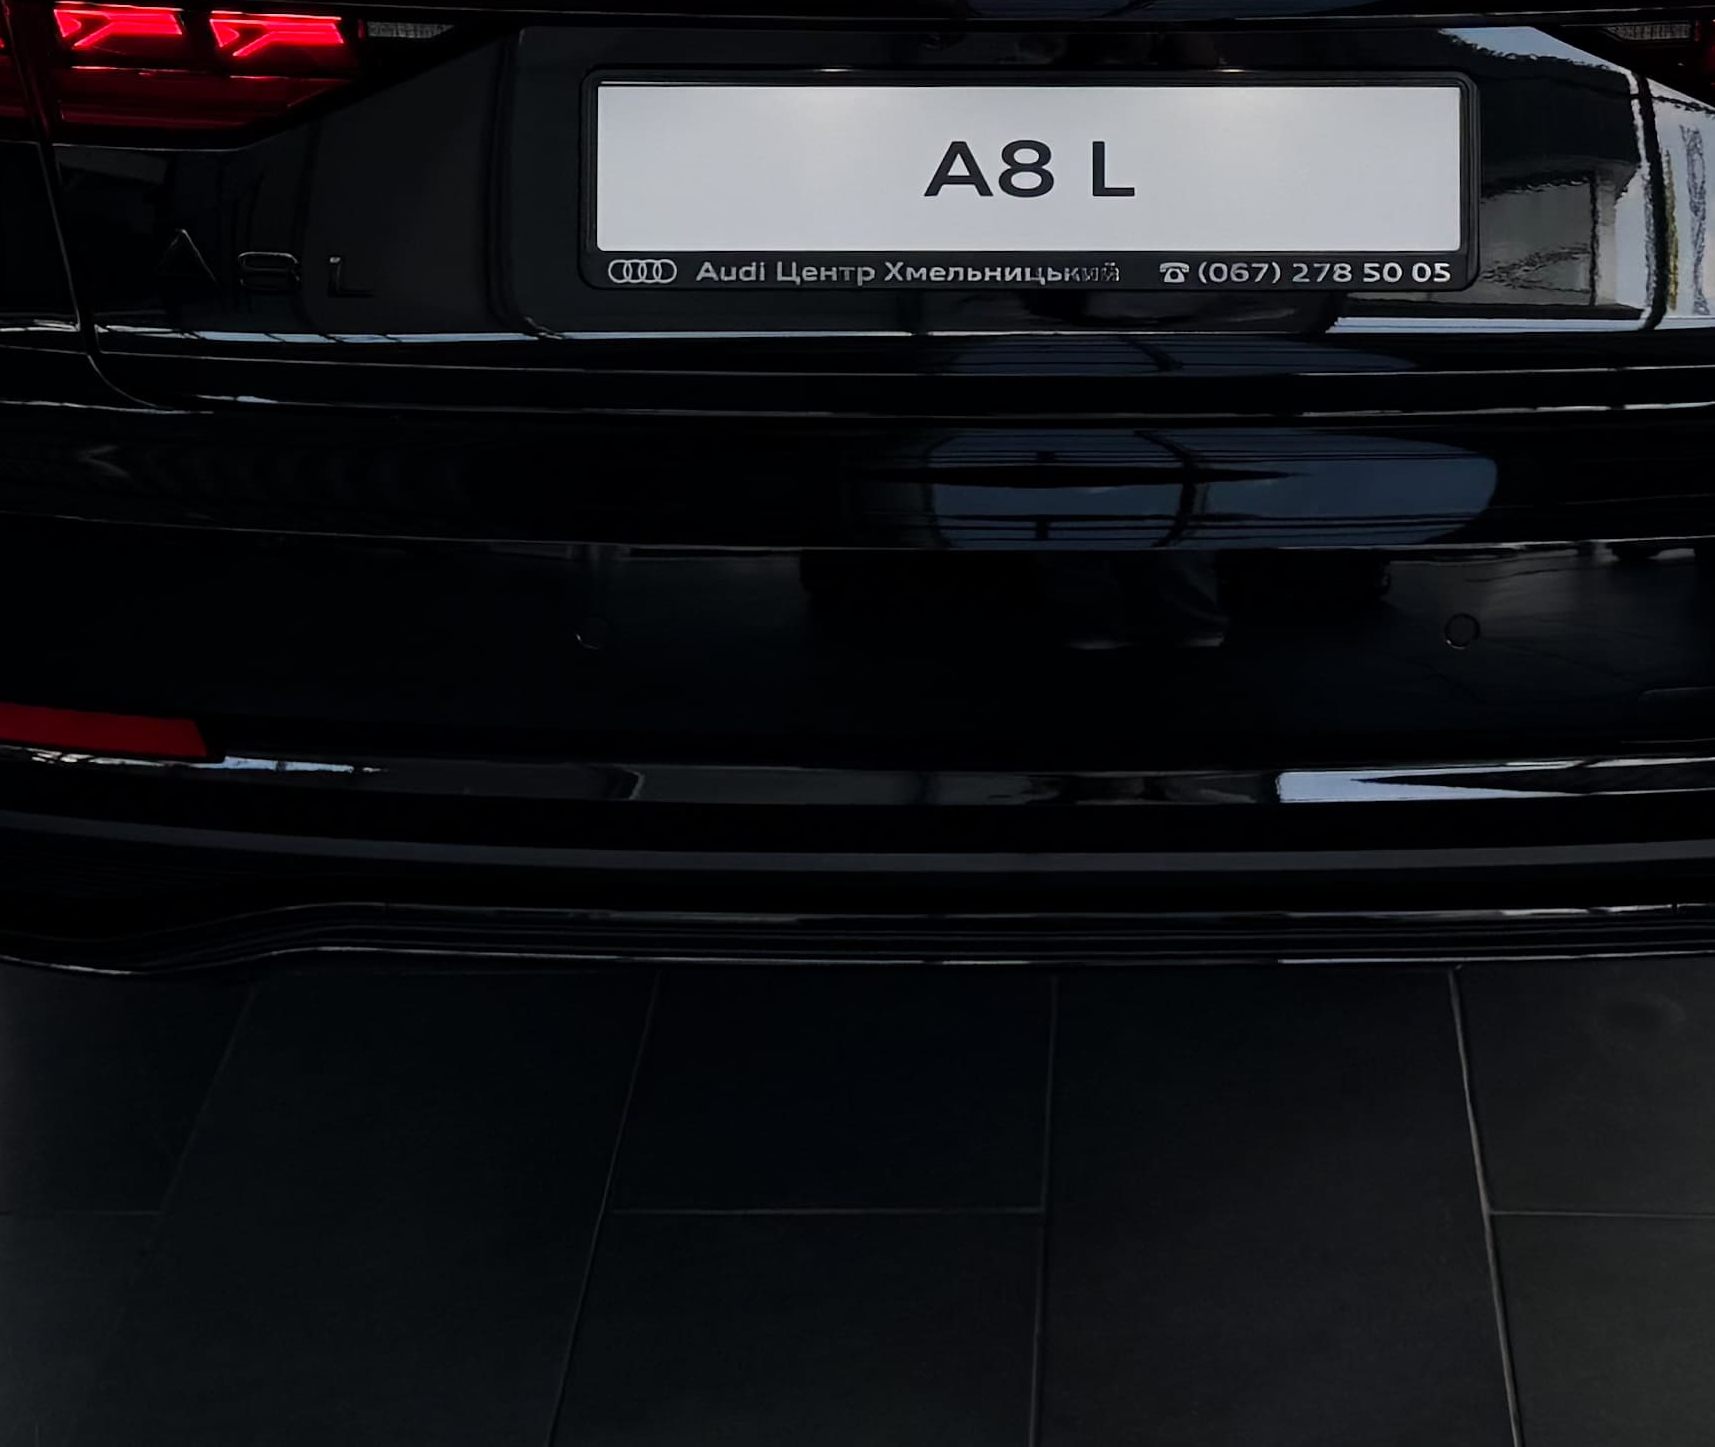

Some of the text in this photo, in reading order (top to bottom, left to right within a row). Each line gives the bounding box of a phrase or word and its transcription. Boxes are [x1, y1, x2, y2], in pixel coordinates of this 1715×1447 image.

[924, 139, 1135, 198] A8 L
[695, 260, 1451, 287] Audi Центр Хмельницький (067) 278 50 05
